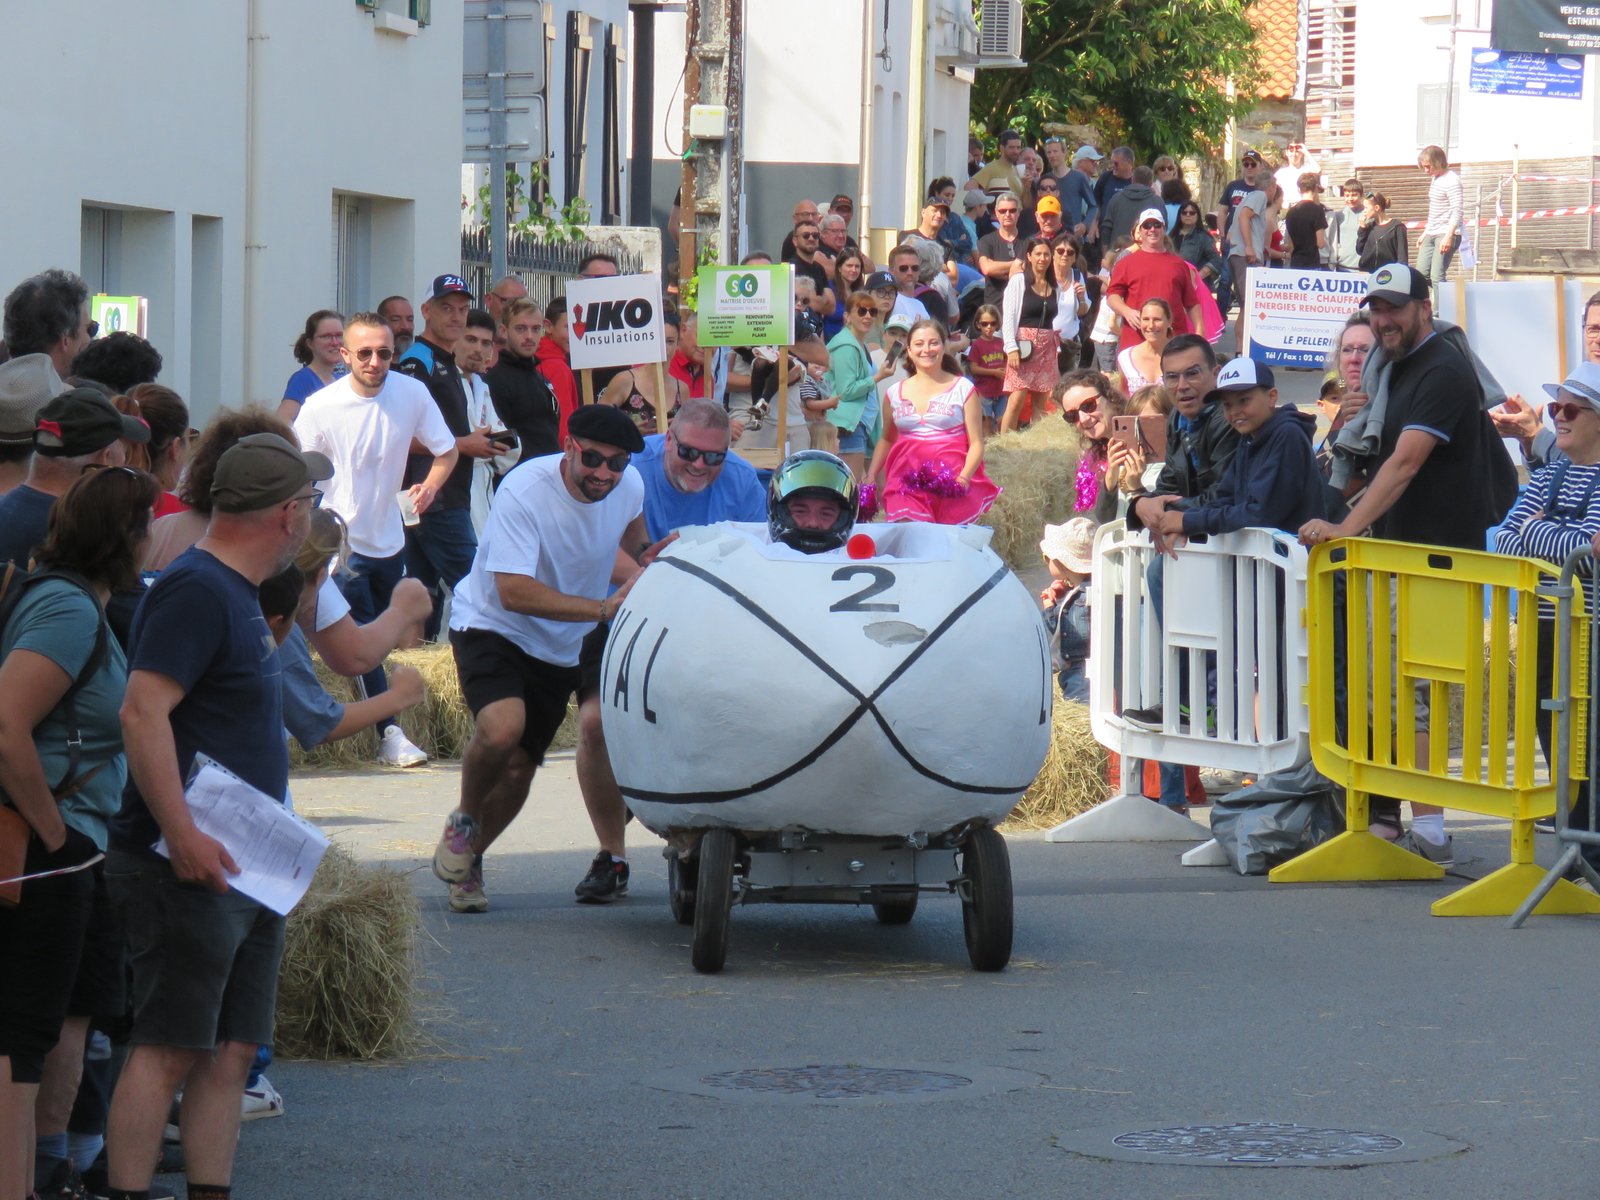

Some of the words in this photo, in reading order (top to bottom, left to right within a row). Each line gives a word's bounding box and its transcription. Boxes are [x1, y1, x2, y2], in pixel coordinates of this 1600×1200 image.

[1256, 281, 1293, 290] Laurent
[1255, 291, 1308, 301] PLOMBERIE
[1254, 302, 1297, 312] ENERGIES
[584, 298, 653, 332] IKO
[585, 330, 655, 346] Insulations
[1283, 336, 1293, 344] LE
[1303, 354, 1313, 362] 02
[1219, 369, 1241, 383] FILA
[829, 565, 900, 613] 2
